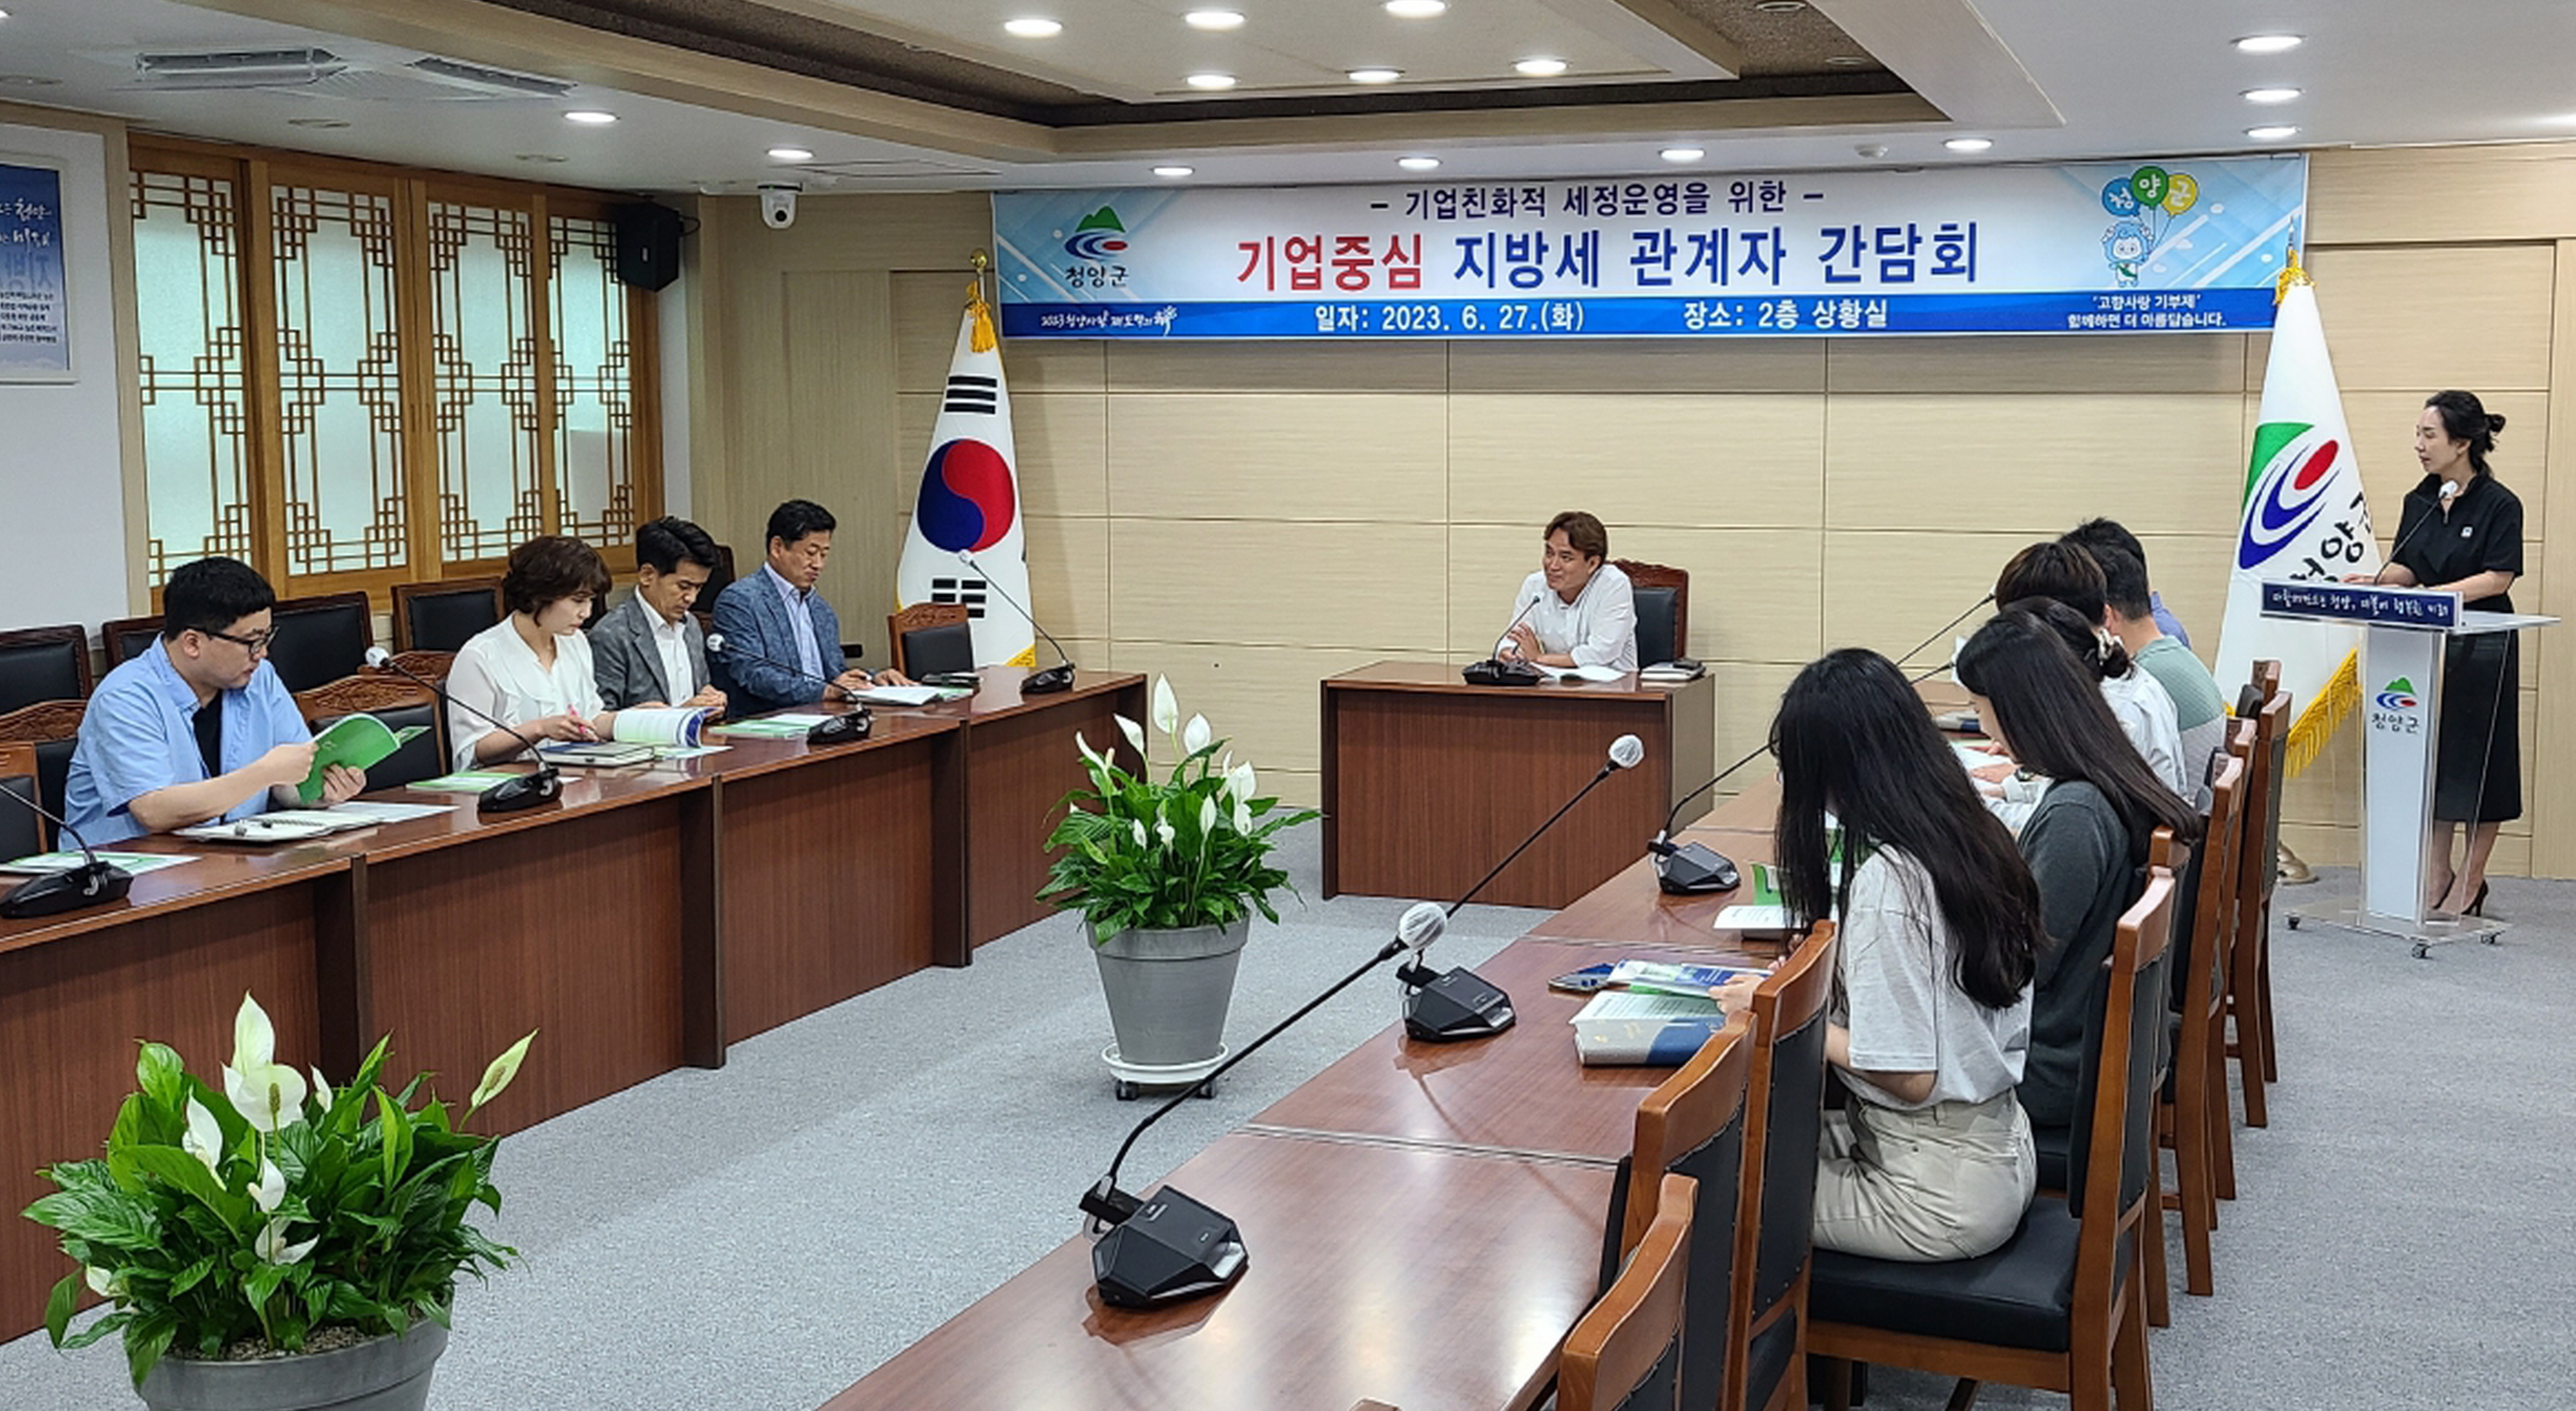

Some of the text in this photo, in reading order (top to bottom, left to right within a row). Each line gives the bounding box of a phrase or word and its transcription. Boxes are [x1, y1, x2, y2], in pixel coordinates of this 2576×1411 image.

[1405, 186, 1546, 220] 기업친화적
[1562, 182, 1711, 217] 세정운영을
[1728, 180, 1787, 213] 위한
[1238, 221, 1977, 291] 기업중심 지방세 관계자 간담회
[1066, 265, 1128, 288] 청양군
[1315, 301, 1583, 332] 일자: 2023. 6. 27.(화)
[1684, 299, 1887, 330] 장소: 2층 상황실
[2123, 313, 2137, 328] 더
[2141, 311, 2227, 328] 아름답습니다.
[2371, 713, 2419, 734] 청양군
